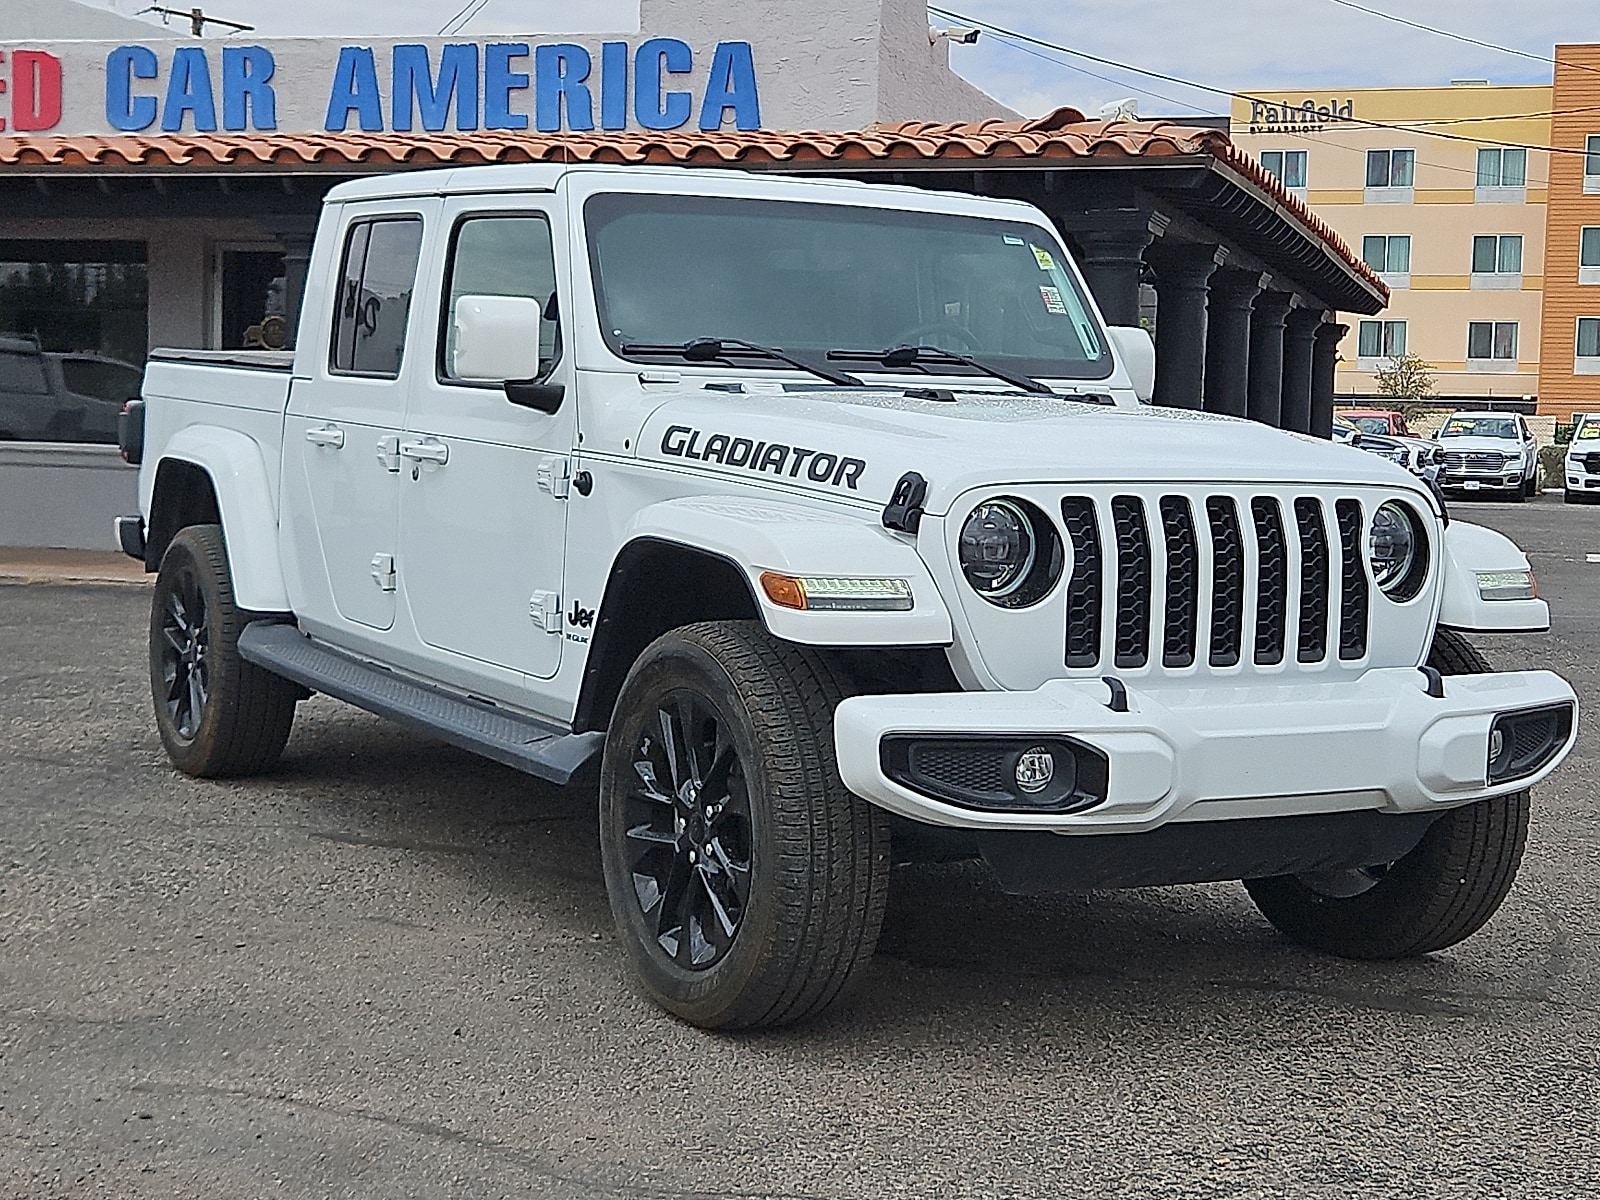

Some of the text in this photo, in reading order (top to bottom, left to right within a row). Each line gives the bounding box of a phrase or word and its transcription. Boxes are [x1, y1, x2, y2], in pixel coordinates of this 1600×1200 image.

[0, 38, 761, 131] D CAR AMERICA
[1249, 99, 1354, 124] Fairfield
[661, 425, 866, 490] GLADIATOR
